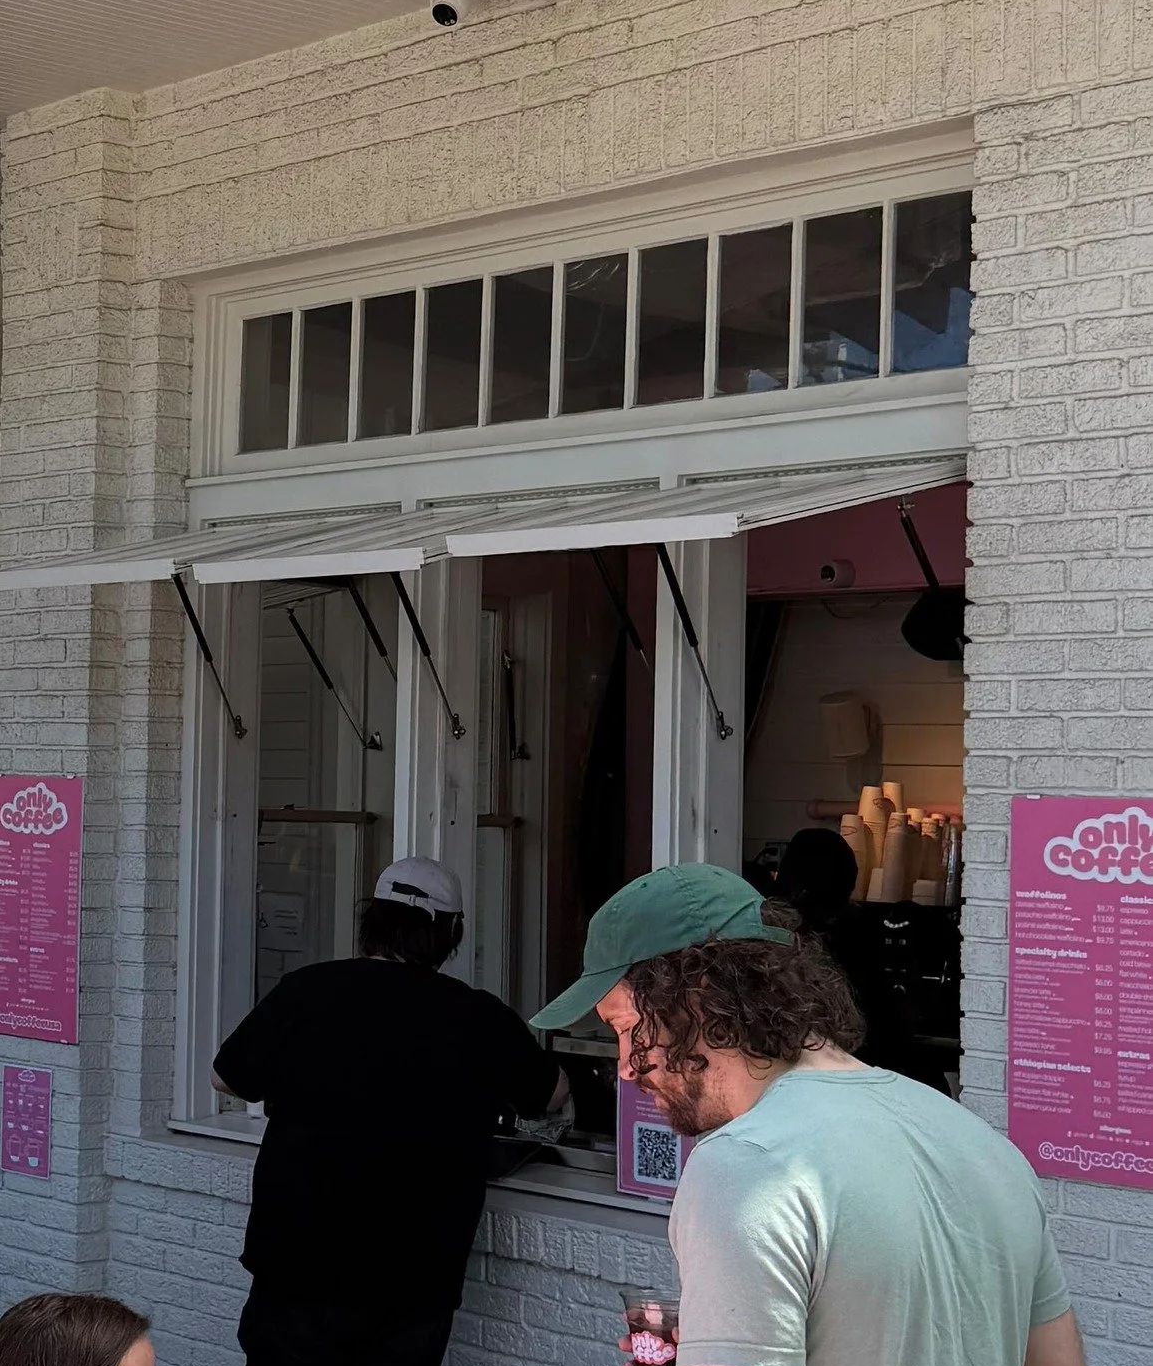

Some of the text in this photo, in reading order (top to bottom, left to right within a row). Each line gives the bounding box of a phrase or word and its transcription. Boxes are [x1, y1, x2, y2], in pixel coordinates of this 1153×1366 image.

[16, 787, 53, 813] only
[2, 807, 64, 830] coffee
[1079, 814, 1153, 852] only
[1015, 946, 1087, 959] specialty drinks
[1013, 1059, 1091, 1073] ethiopian selects
[634, 1346, 675, 1363] ffee
